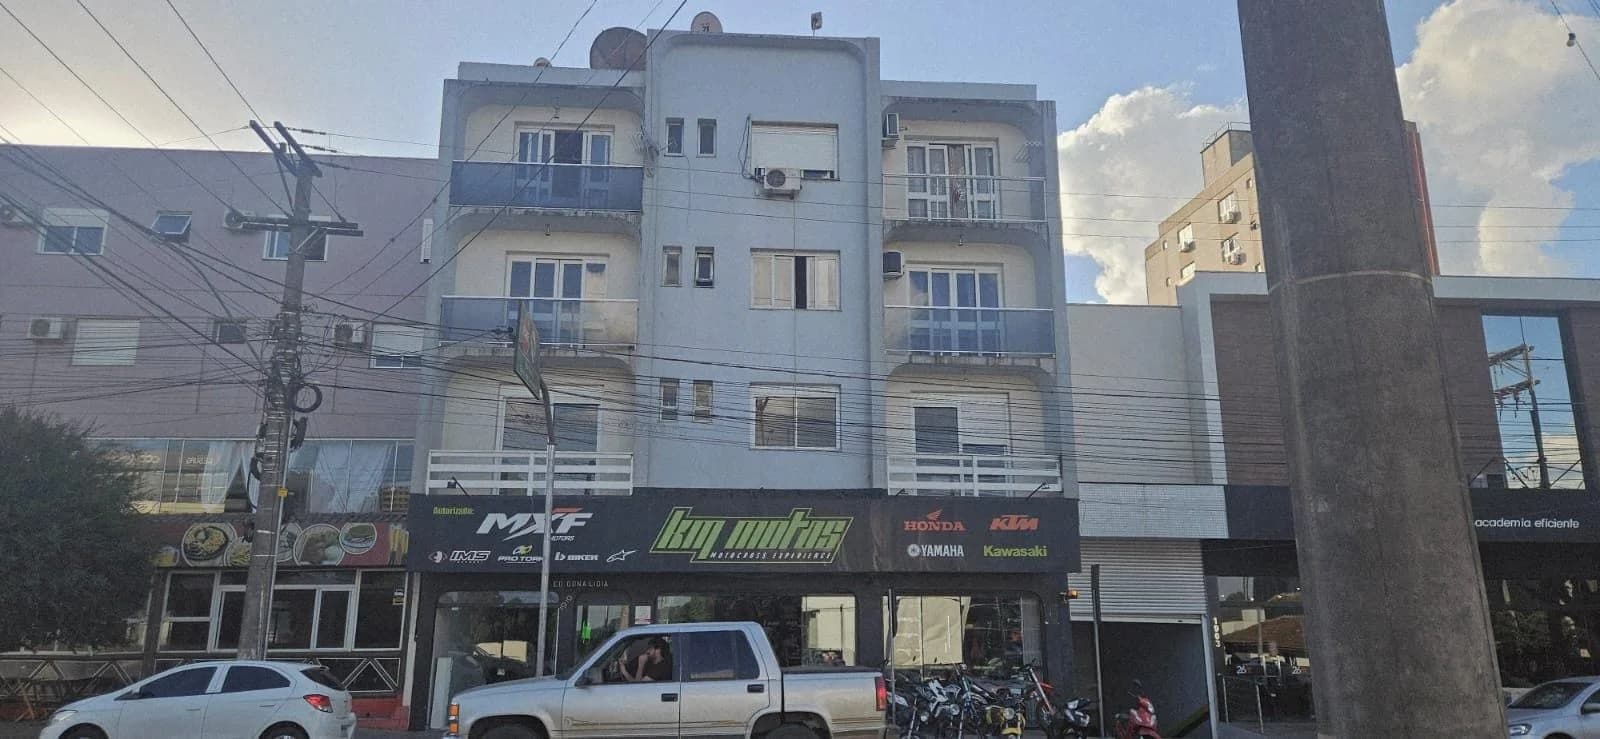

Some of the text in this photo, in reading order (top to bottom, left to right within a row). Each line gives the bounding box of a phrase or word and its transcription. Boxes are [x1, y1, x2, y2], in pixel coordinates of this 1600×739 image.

[476, 512, 594, 541] MXF
[904, 521, 967, 531] HONDA
[990, 514, 1039, 531] KTM
[1475, 517, 1580, 529] academia eficiente
[450, 550, 491, 561] IMS
[710, 552, 832, 560] MOTOCROSS EXPERIENCE
[921, 544, 965, 557] YAMAHA
[984, 545, 1048, 557] Kawasaki
